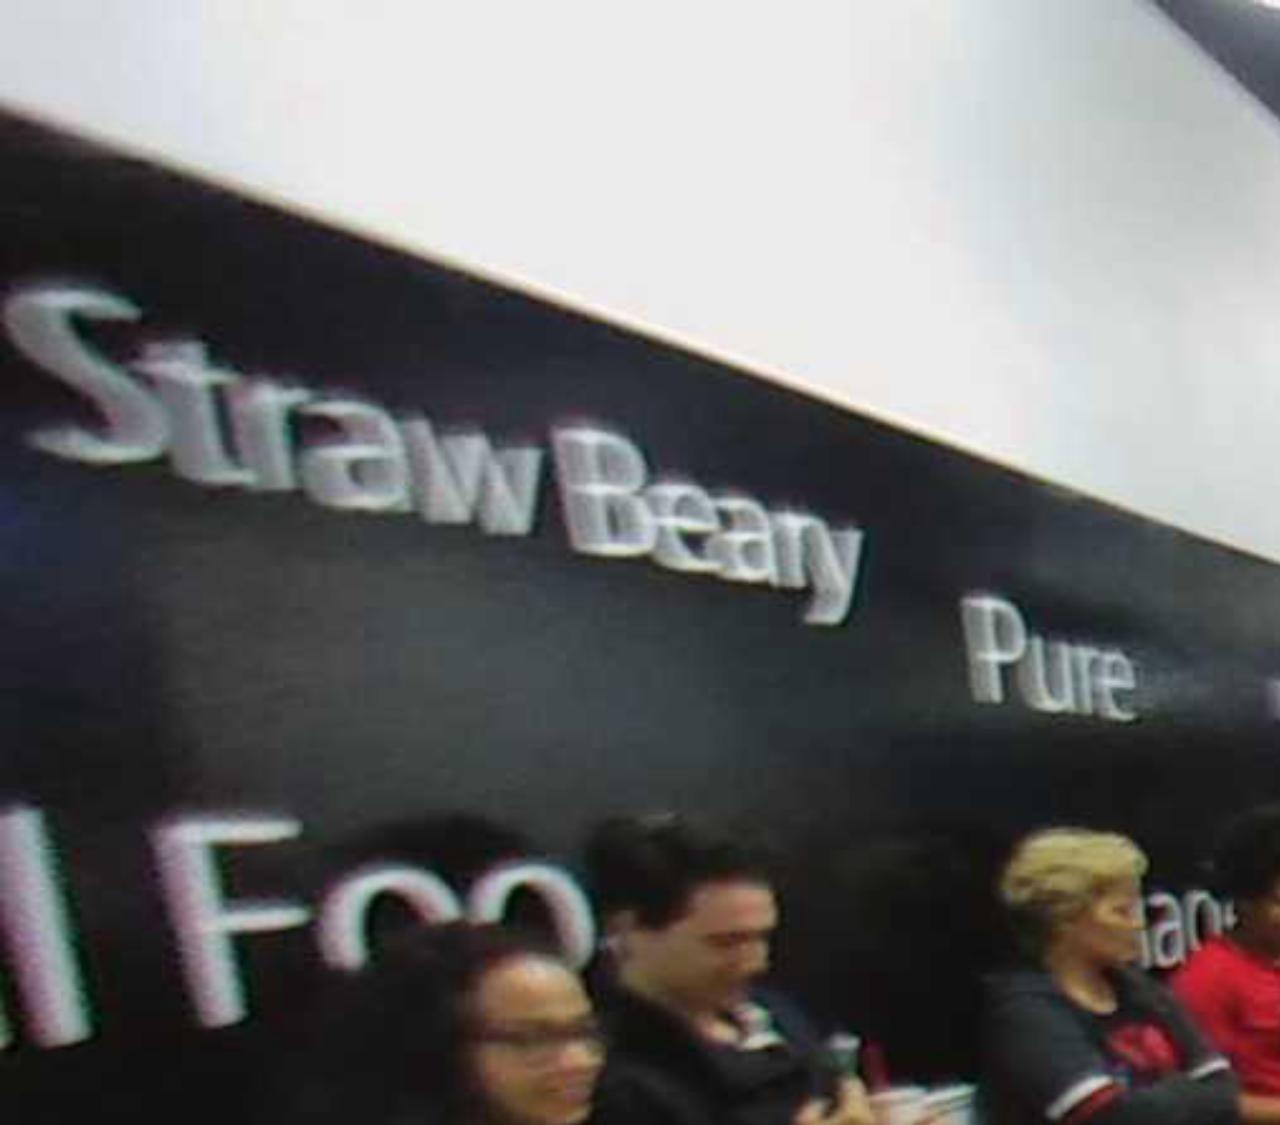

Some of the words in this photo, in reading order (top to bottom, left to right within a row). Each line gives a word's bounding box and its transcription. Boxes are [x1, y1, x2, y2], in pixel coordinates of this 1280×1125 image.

[3, 285, 542, 535] Straw
[550, 426, 863, 626] Beary
[960, 595, 1139, 721] Pure
